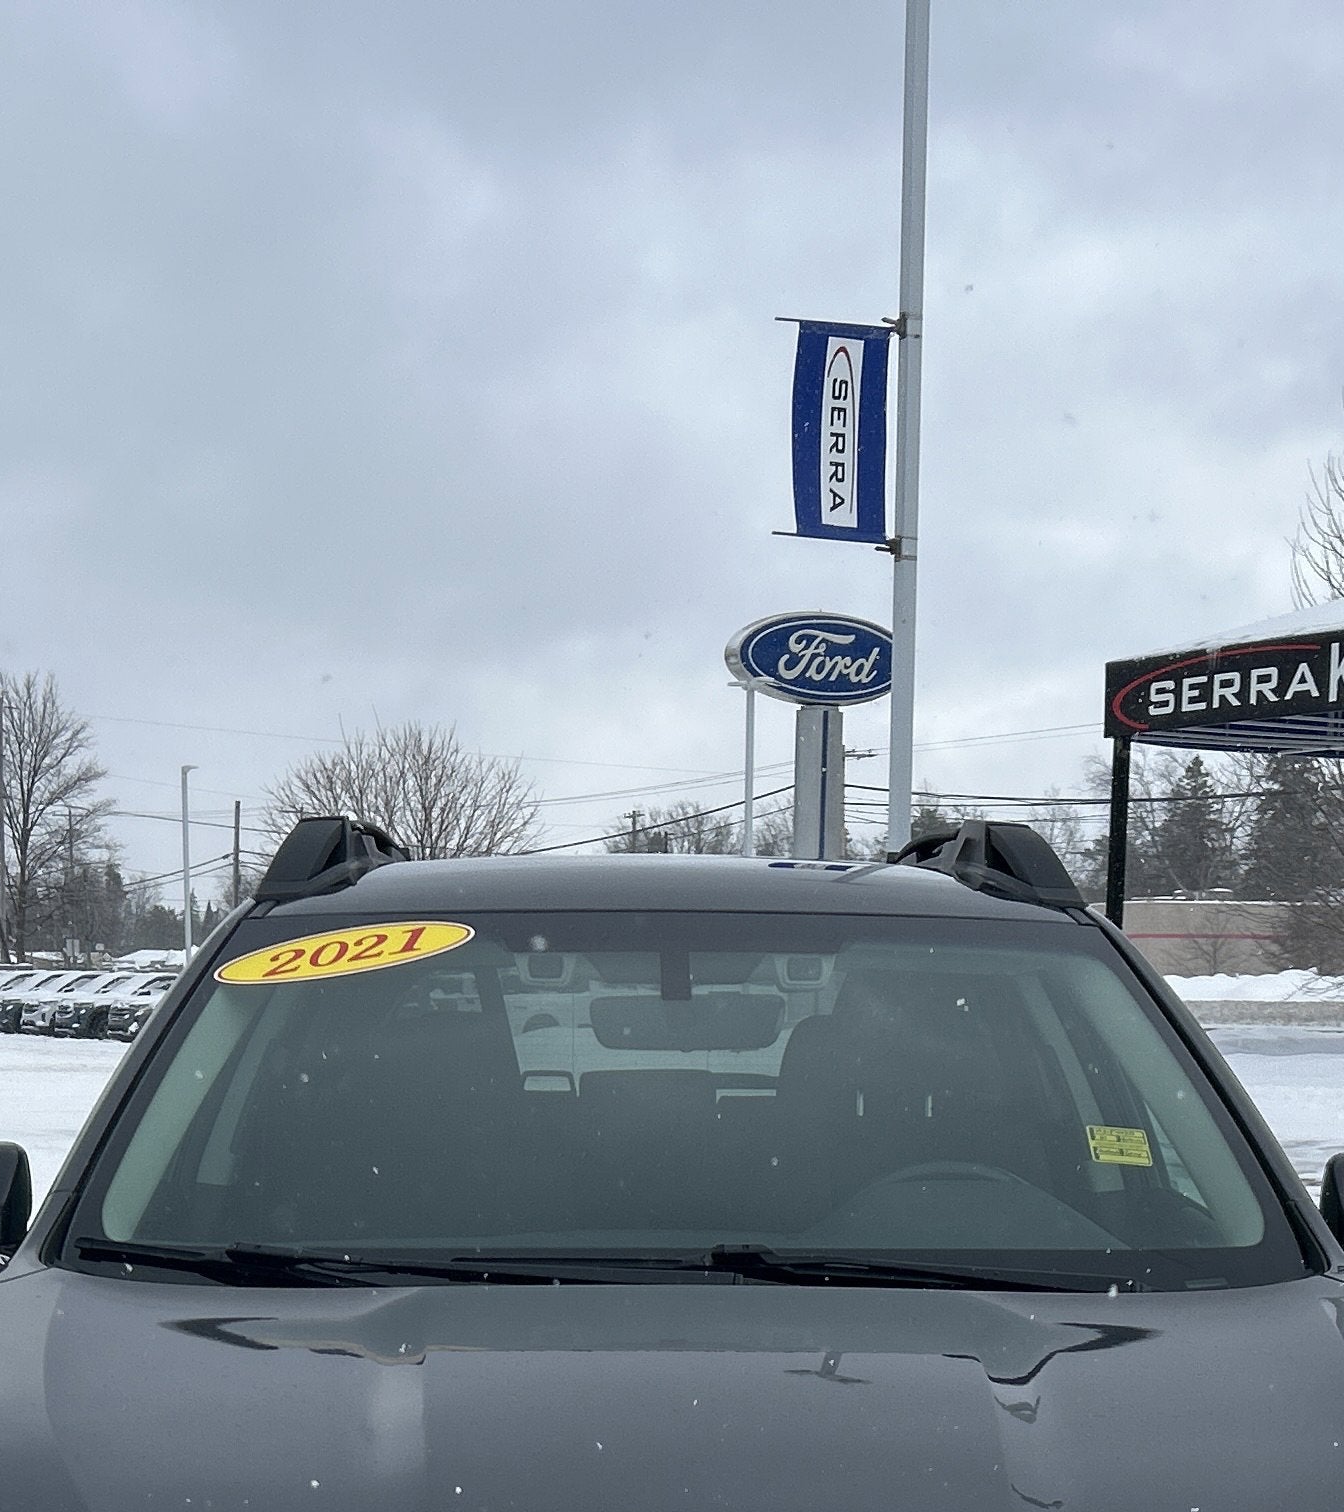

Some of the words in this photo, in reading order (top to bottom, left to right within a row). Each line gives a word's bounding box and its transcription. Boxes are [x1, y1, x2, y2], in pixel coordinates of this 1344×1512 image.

[828, 376, 849, 514] SERRA
[777, 628, 882, 684] Ford
[1148, 662, 1321, 716] SERRA
[261, 926, 427, 978] 2021
